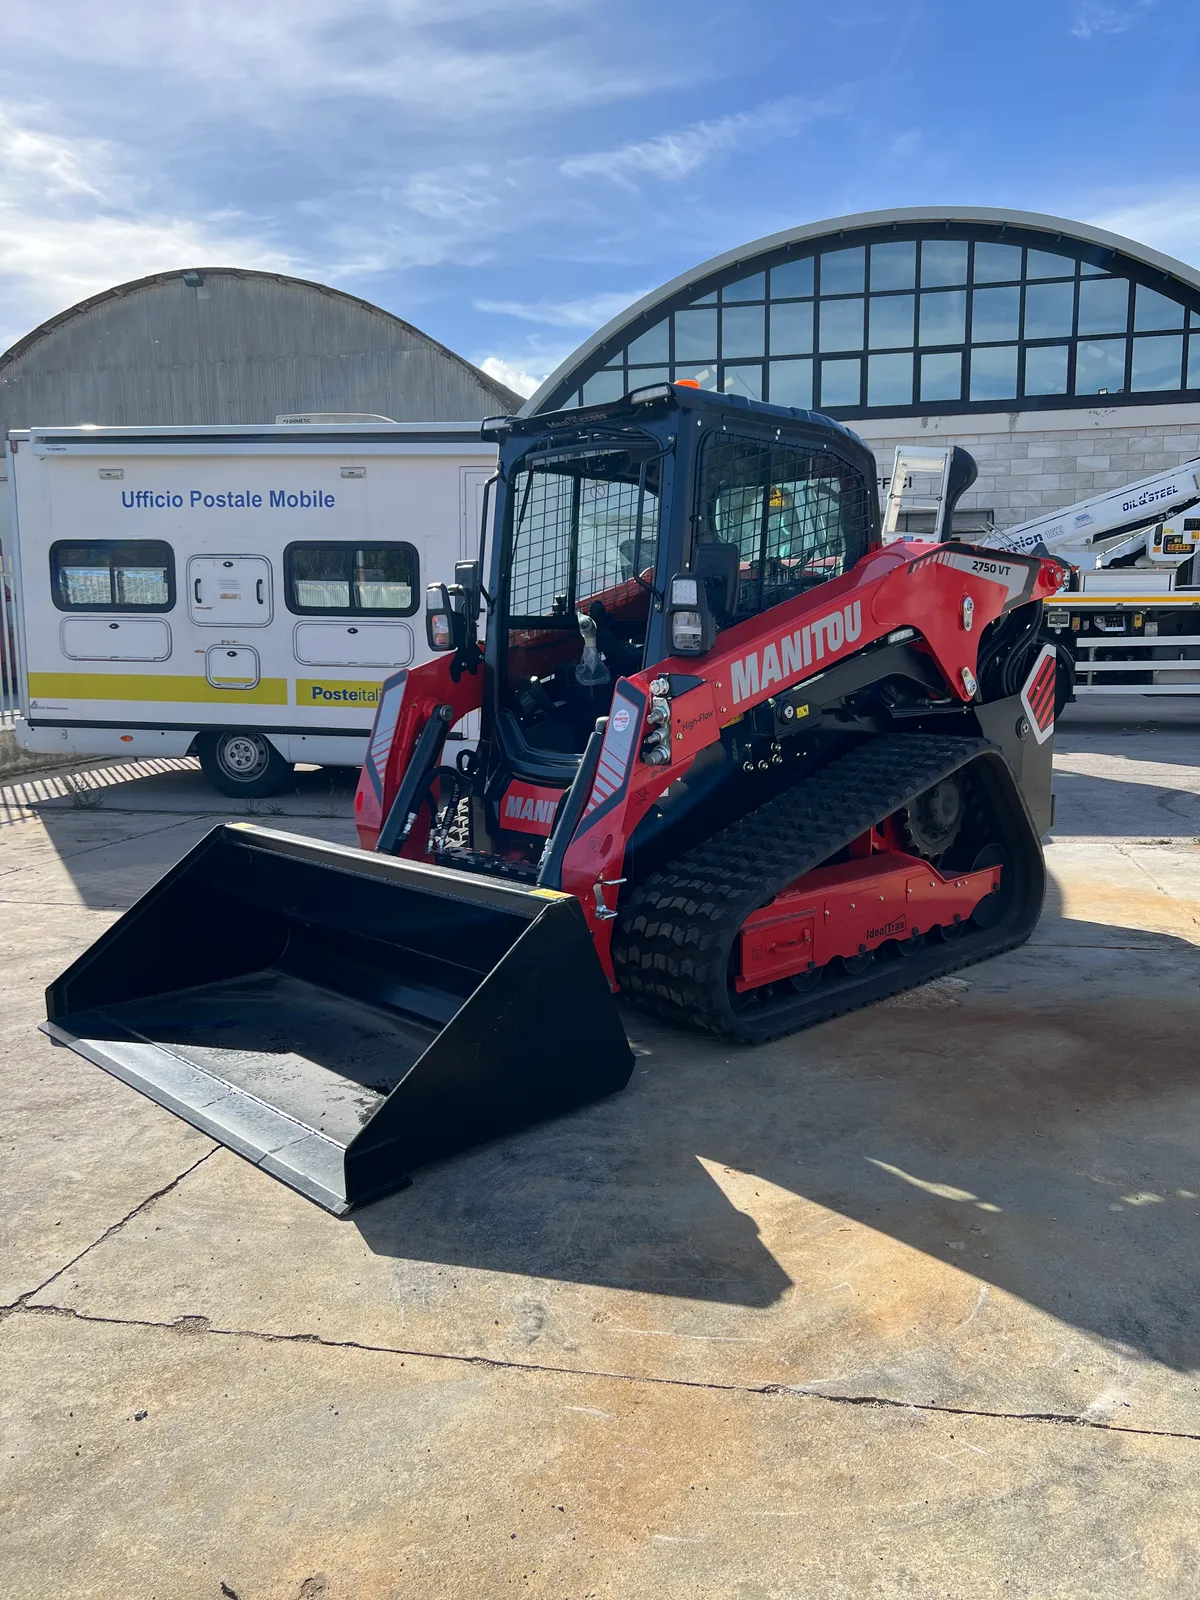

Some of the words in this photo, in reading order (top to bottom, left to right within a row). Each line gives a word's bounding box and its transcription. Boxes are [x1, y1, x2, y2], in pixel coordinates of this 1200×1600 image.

[121, 490, 184, 508] Ufficio
[190, 490, 263, 508] Postale
[269, 490, 335, 508] Mobile
[972, 560, 996, 574] 2750
[998, 564, 1011, 576] VT
[730, 599, 862, 705] MANITOU
[505, 796, 558, 824] MANI
